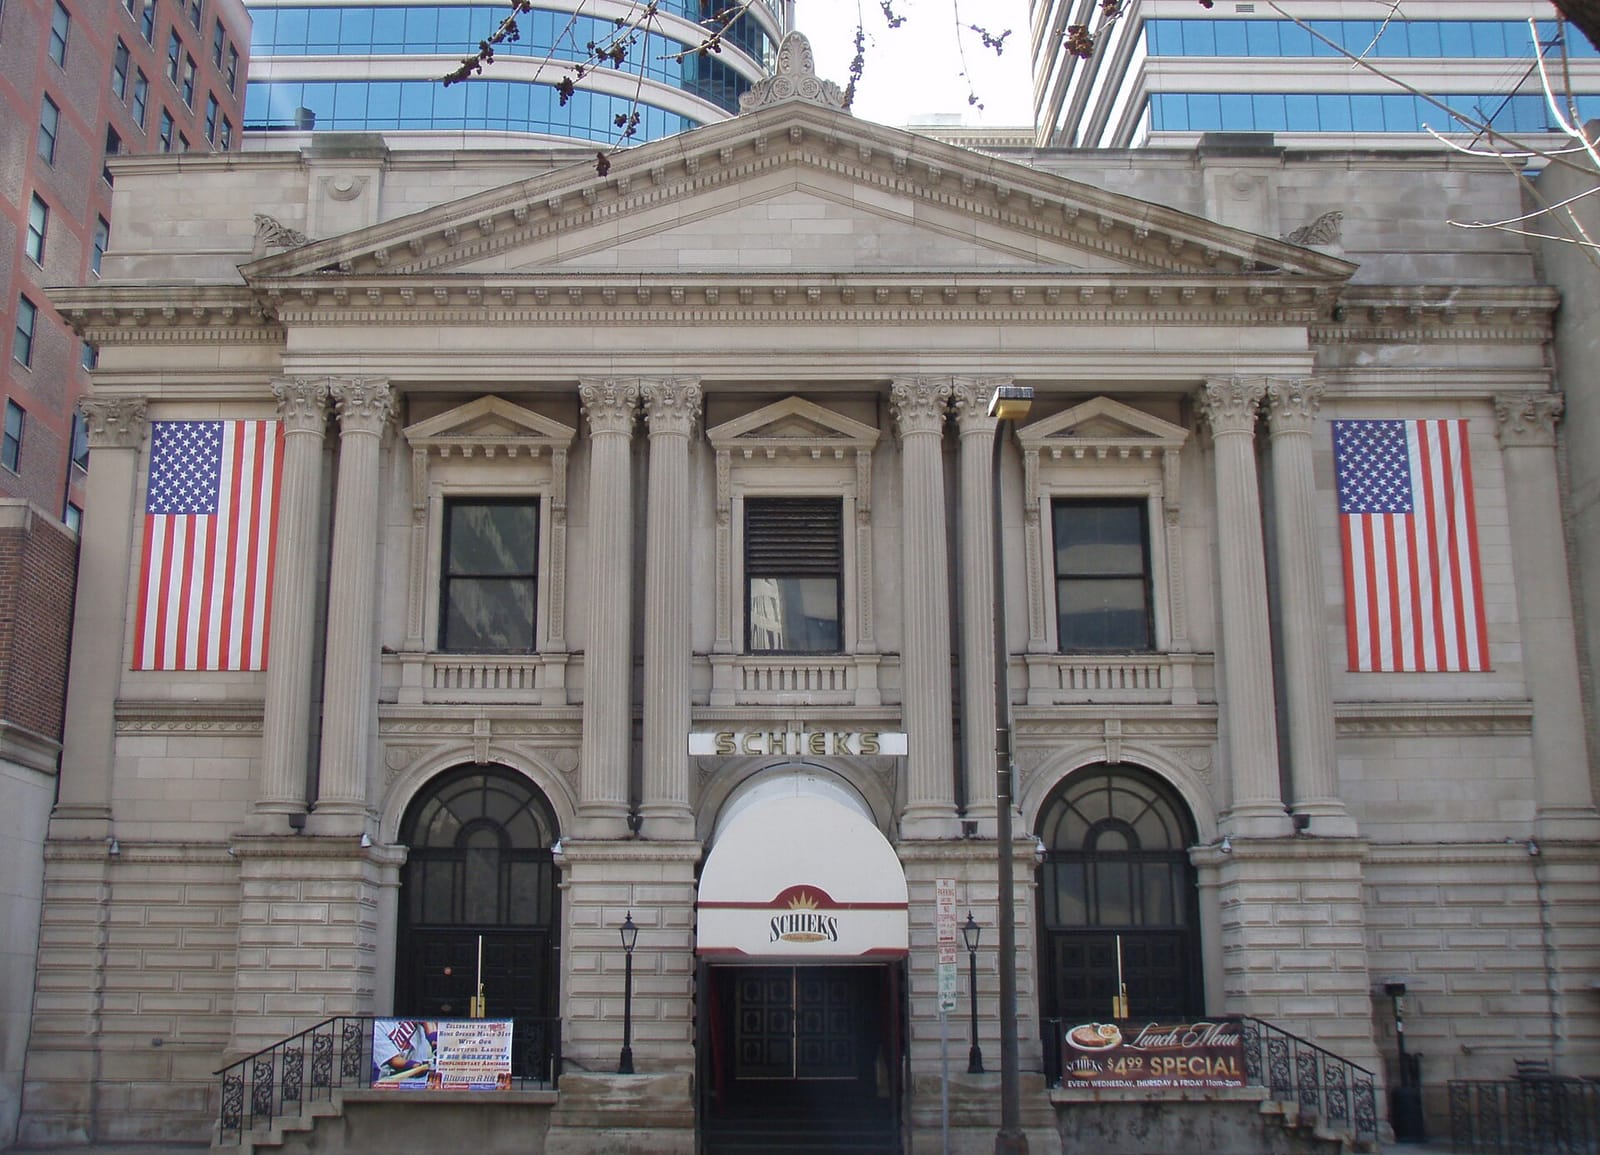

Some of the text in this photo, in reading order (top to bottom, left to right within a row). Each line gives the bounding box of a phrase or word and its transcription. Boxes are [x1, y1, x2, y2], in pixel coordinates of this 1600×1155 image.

[714, 732, 880, 756] SCHIEKS
[769, 914, 838, 942] SCHIEKS
[1123, 1023, 1240, 1050] Lunch Menu
[1150, 1056, 1241, 1076] SPECIAL
[1067, 1080, 1090, 1088] EVERY
[1136, 1080, 1171, 1088] THURSDAY
